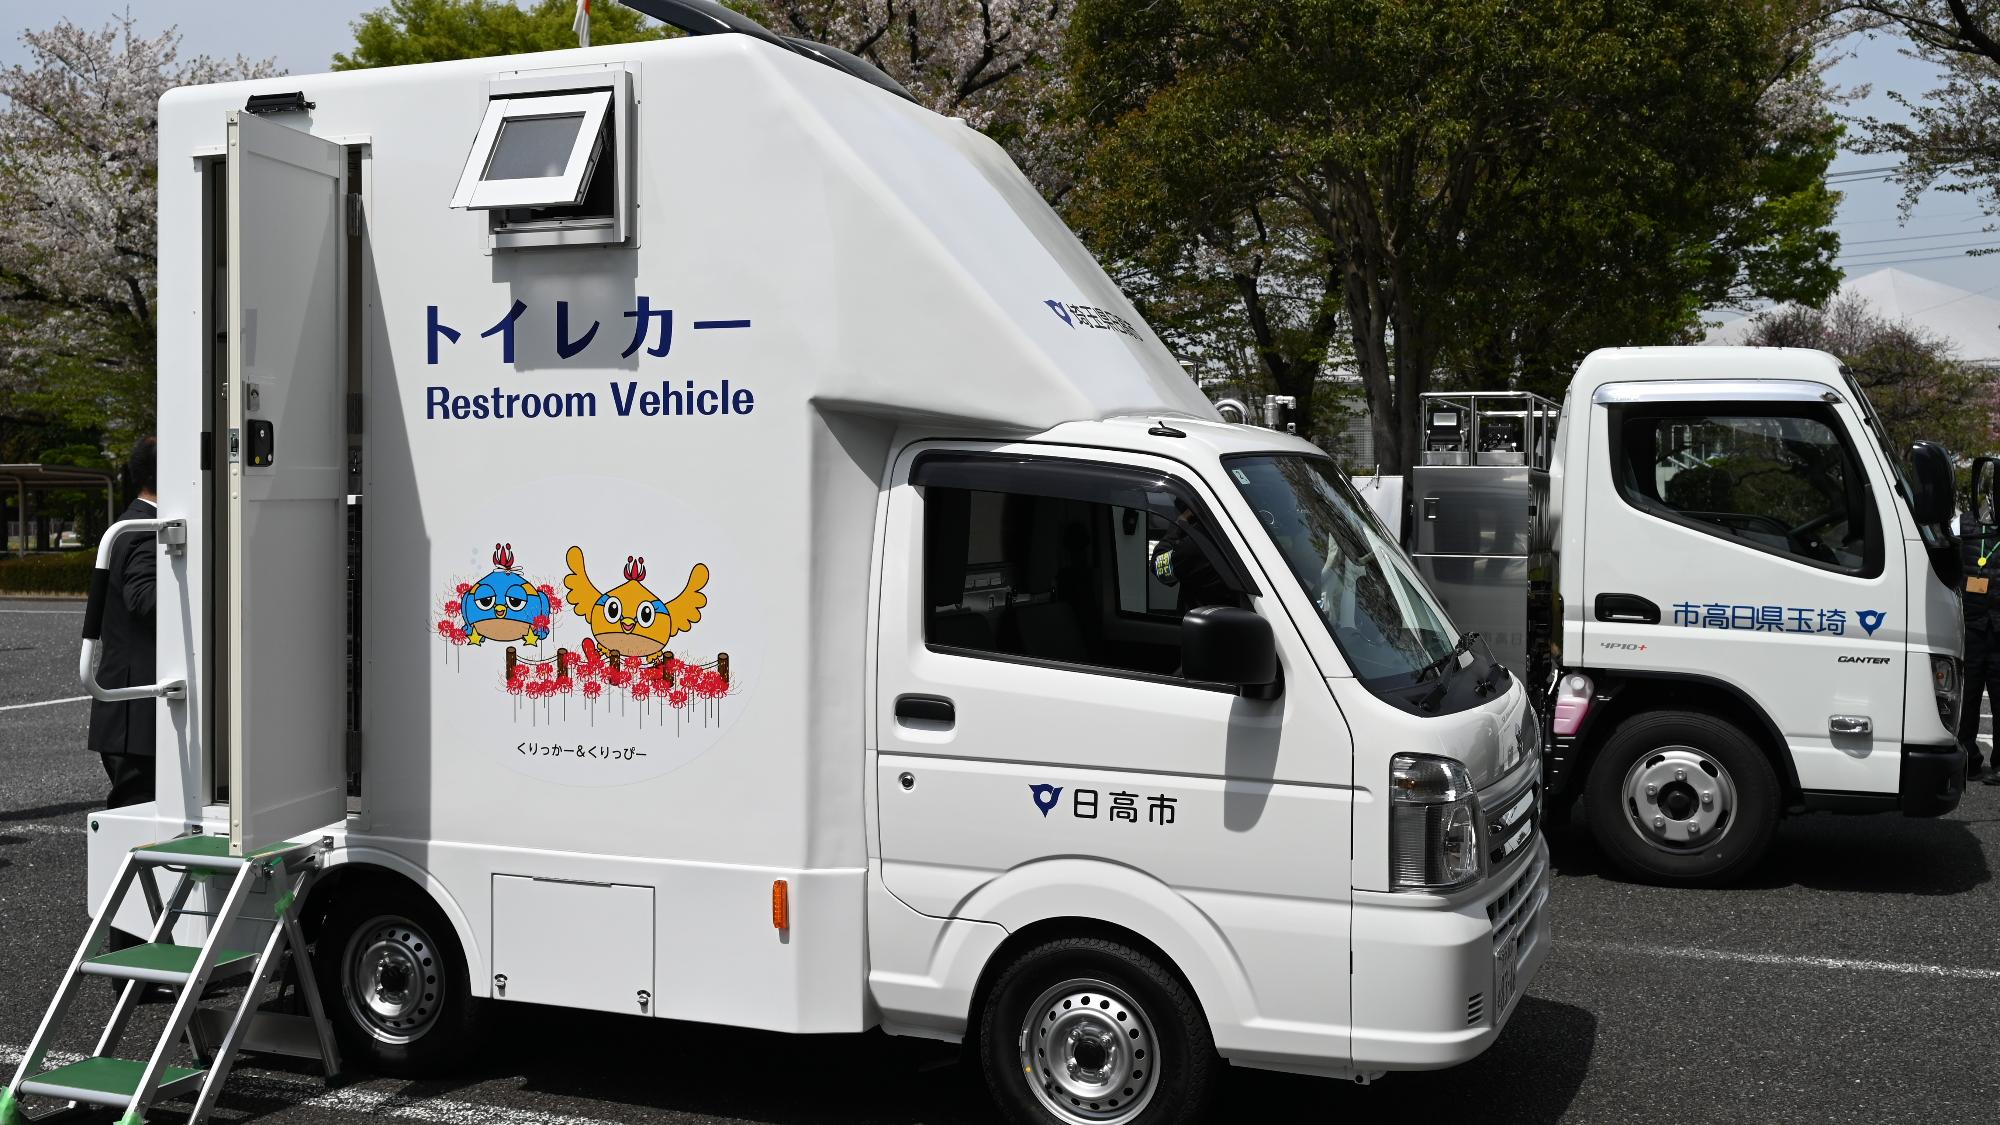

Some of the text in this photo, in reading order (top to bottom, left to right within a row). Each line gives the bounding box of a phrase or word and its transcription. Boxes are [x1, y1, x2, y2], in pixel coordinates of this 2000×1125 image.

[426, 296, 751, 365] トイレカー
[426, 379, 755, 420] Restroom Vehicle
[517, 742, 647, 760] くりっかー&くりっぴー
[1073, 788, 1178, 826] 日高市
